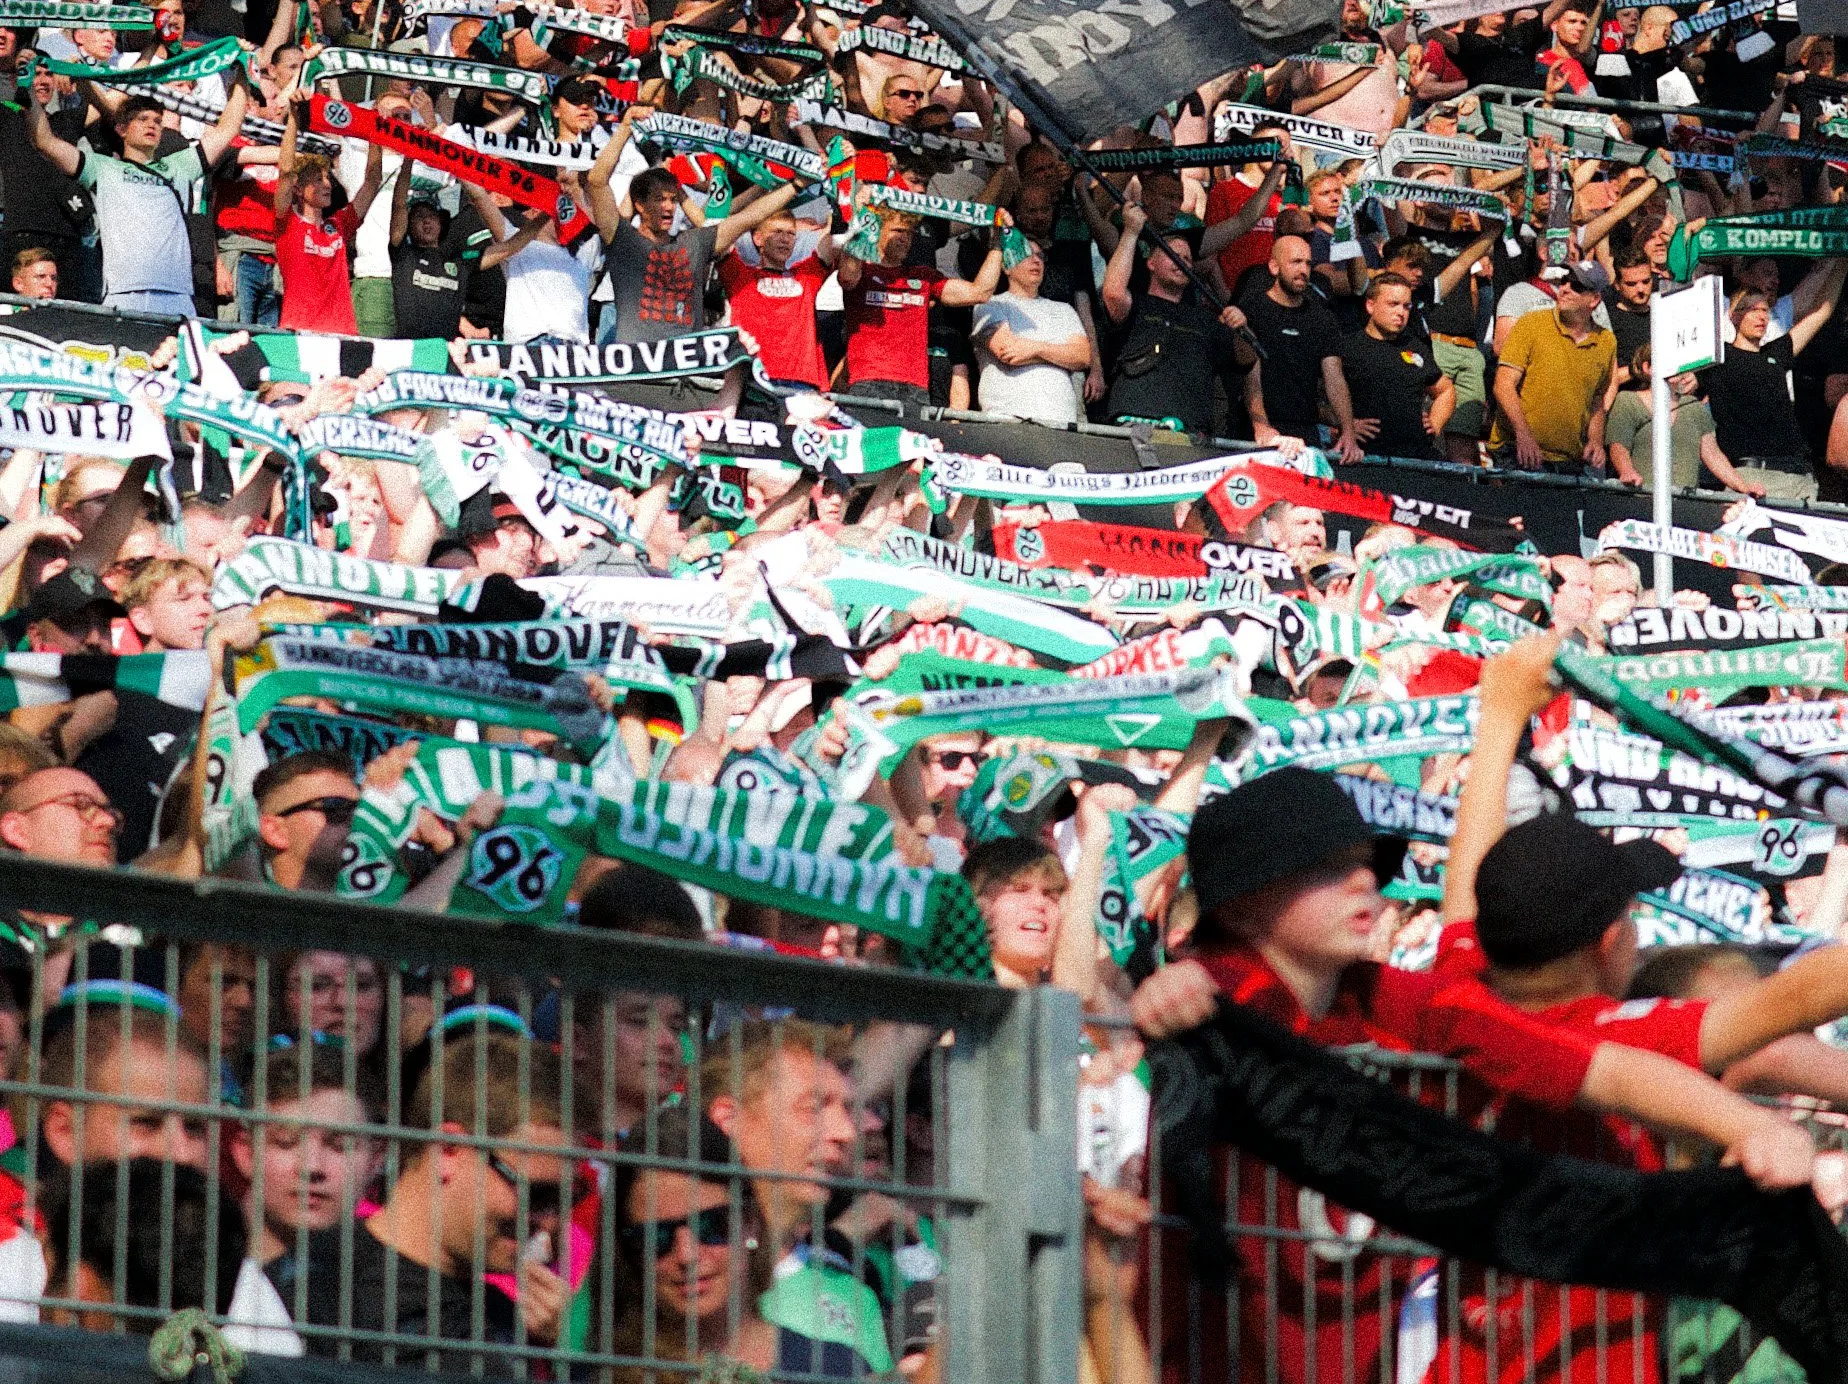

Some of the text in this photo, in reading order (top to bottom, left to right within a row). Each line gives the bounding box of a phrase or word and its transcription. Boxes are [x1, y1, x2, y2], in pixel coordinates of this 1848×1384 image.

[1223, 109, 1345, 141] HANOVER
[376, 117, 536, 193] HANNOVER 96
[472, 332, 731, 382] HANNOVER
[482, 833, 550, 905] 96
[1761, 824, 1801, 864] 96
